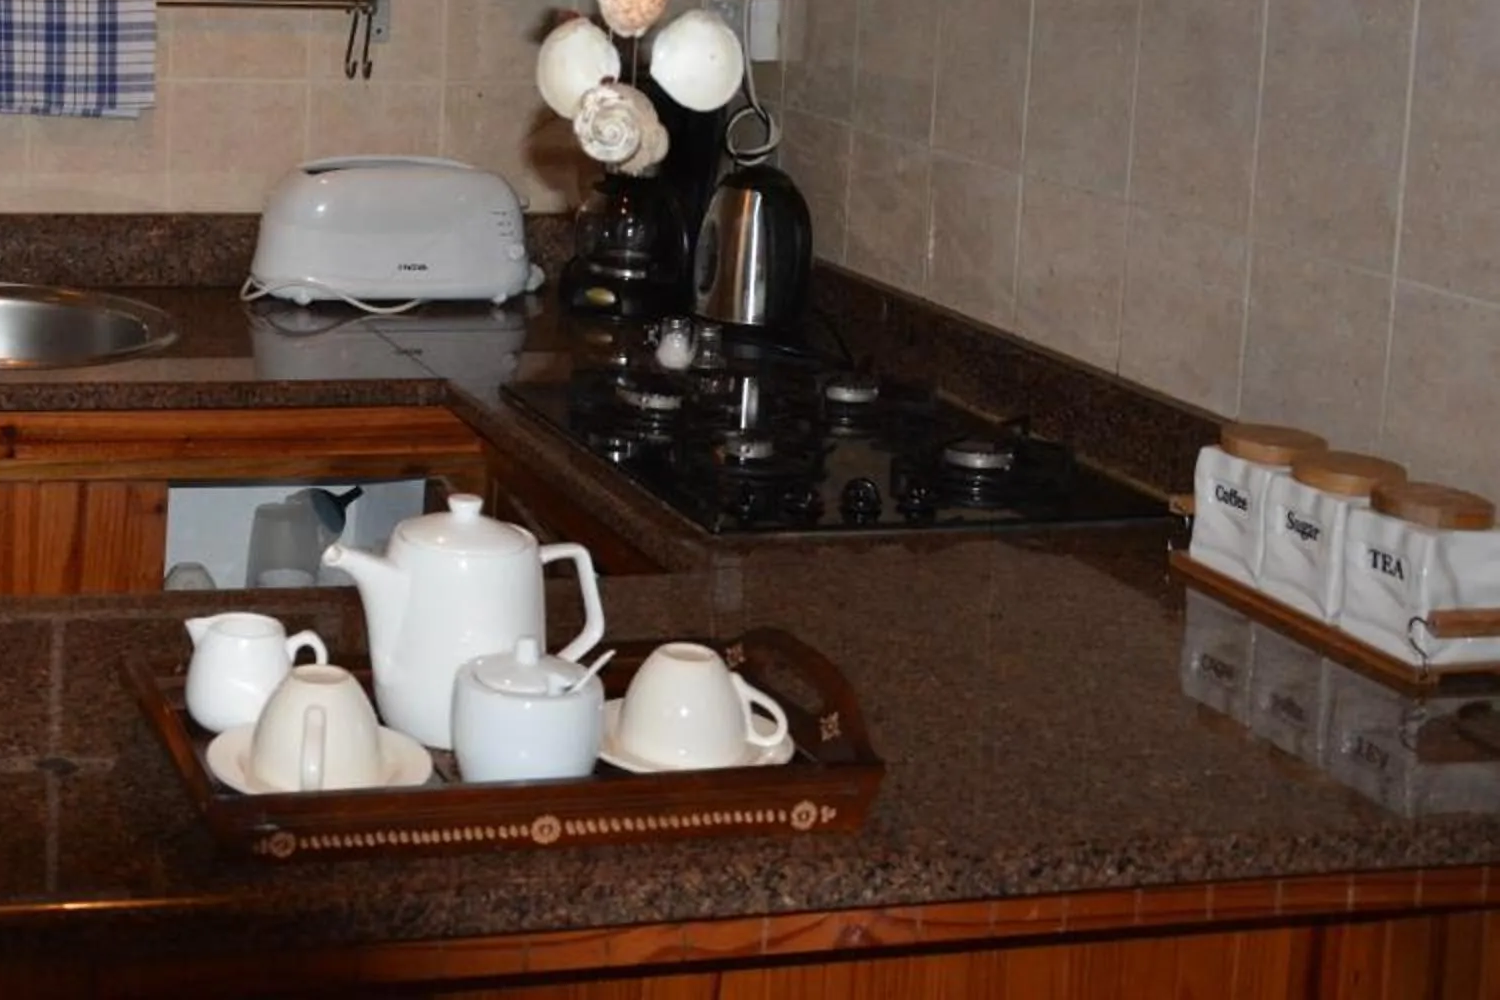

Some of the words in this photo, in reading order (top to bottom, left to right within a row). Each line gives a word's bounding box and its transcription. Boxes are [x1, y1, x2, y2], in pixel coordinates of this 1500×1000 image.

[1215, 484, 1248, 511] Coffee
[1285, 510, 1321, 542] Sugar
[1369, 549, 1404, 580] TEA
